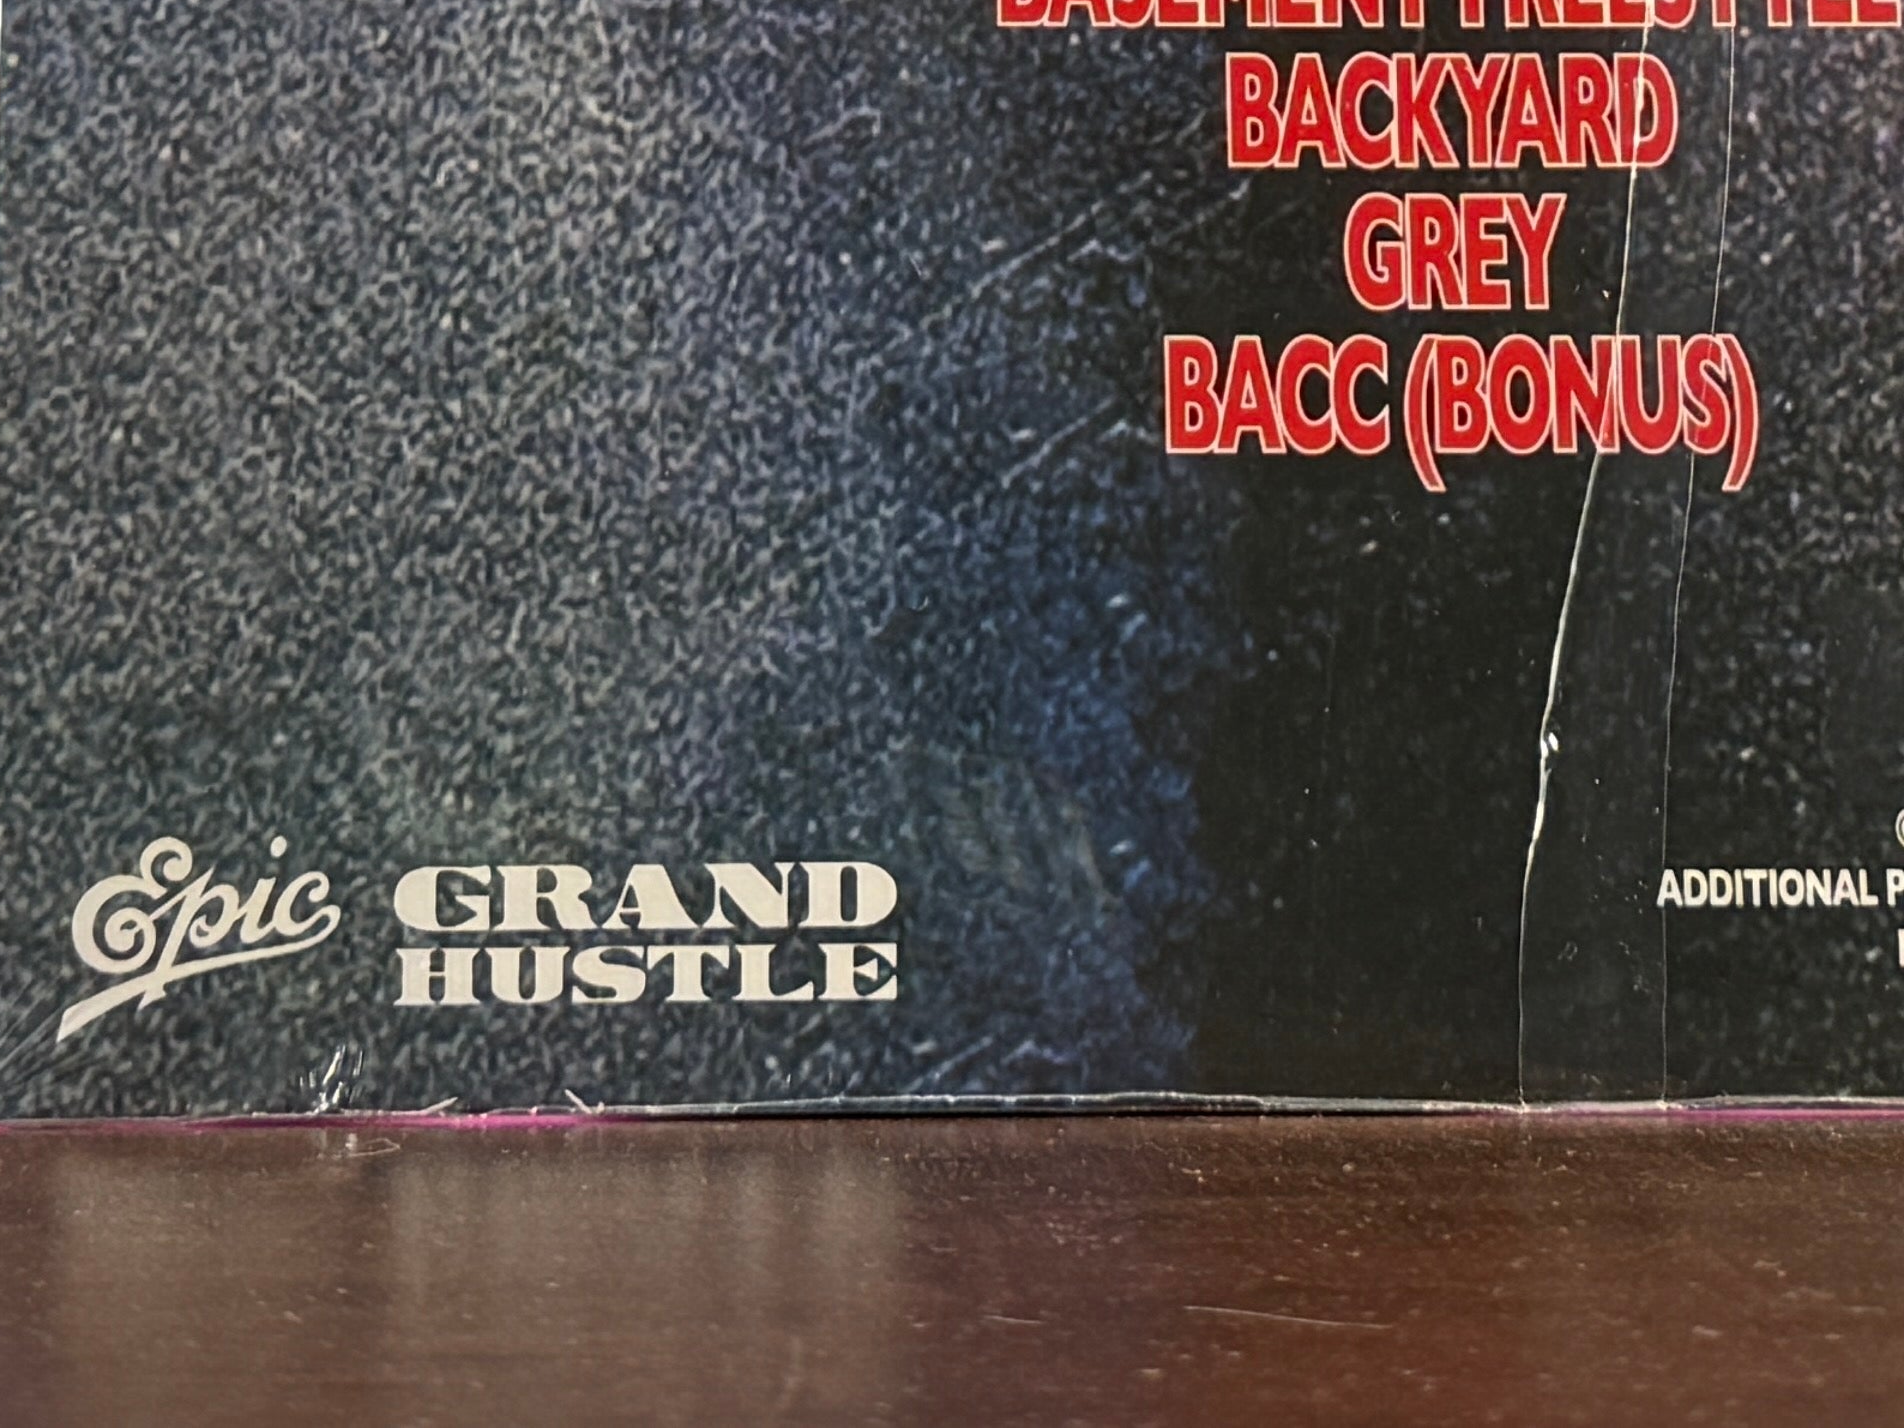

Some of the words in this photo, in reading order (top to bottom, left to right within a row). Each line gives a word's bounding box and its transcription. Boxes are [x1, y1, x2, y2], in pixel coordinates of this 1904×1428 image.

[1225, 51, 1679, 169] BACKYARD
[1342, 192, 1568, 310] GREY
[1163, 333, 1391, 456] BACC
[1404, 333, 1758, 492] (BONUS)
[55, 835, 343, 1043] Epic
[393, 861, 898, 933] GRAND
[1656, 868, 1879, 908] ADDITIONAL
[394, 943, 898, 1008] HUSTLE
